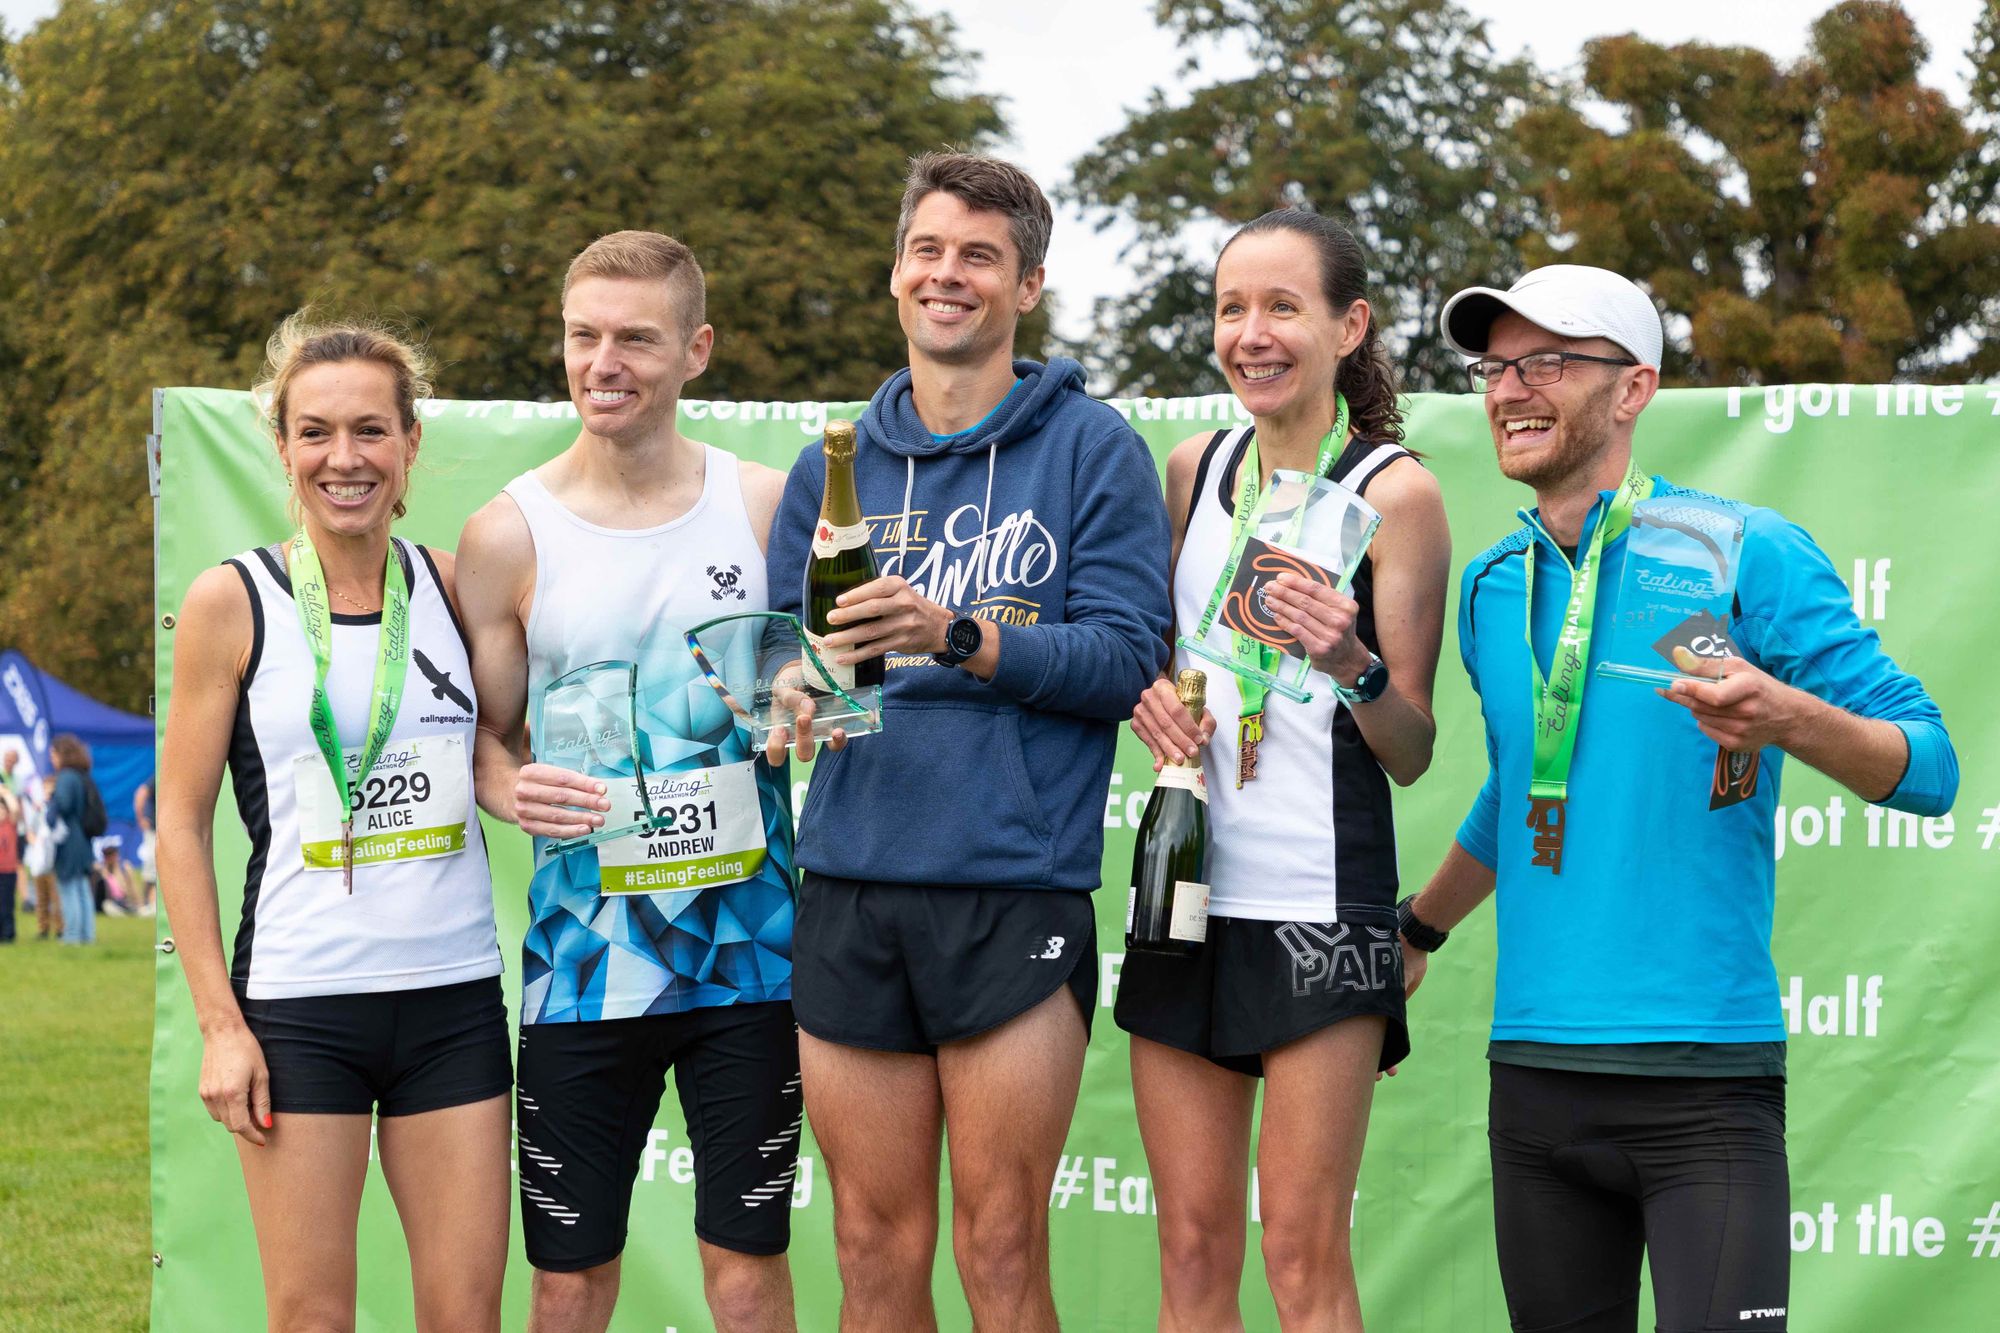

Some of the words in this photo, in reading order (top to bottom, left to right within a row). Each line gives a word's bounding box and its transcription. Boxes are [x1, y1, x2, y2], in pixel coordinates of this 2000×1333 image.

[1635, 569, 1717, 598] Ealing
[384, 586, 406, 665] Ealing
[1564, 597, 1583, 636] HALF
[1545, 645, 1582, 739] Ealing
[552, 729, 622, 752] Ealig
[344, 751, 421, 769] Eing
[347, 771, 431, 812] 5229
[367, 809, 414, 831] ALICE
[1864, 802, 1955, 849] the
[331, 833, 451, 861] #alingFeeling
[647, 835, 715, 859] ANDREW
[624, 861, 743, 886] #EalingFeeling
[1777, 975, 1883, 1037] Half
[1856, 1193, 1945, 1258] the
